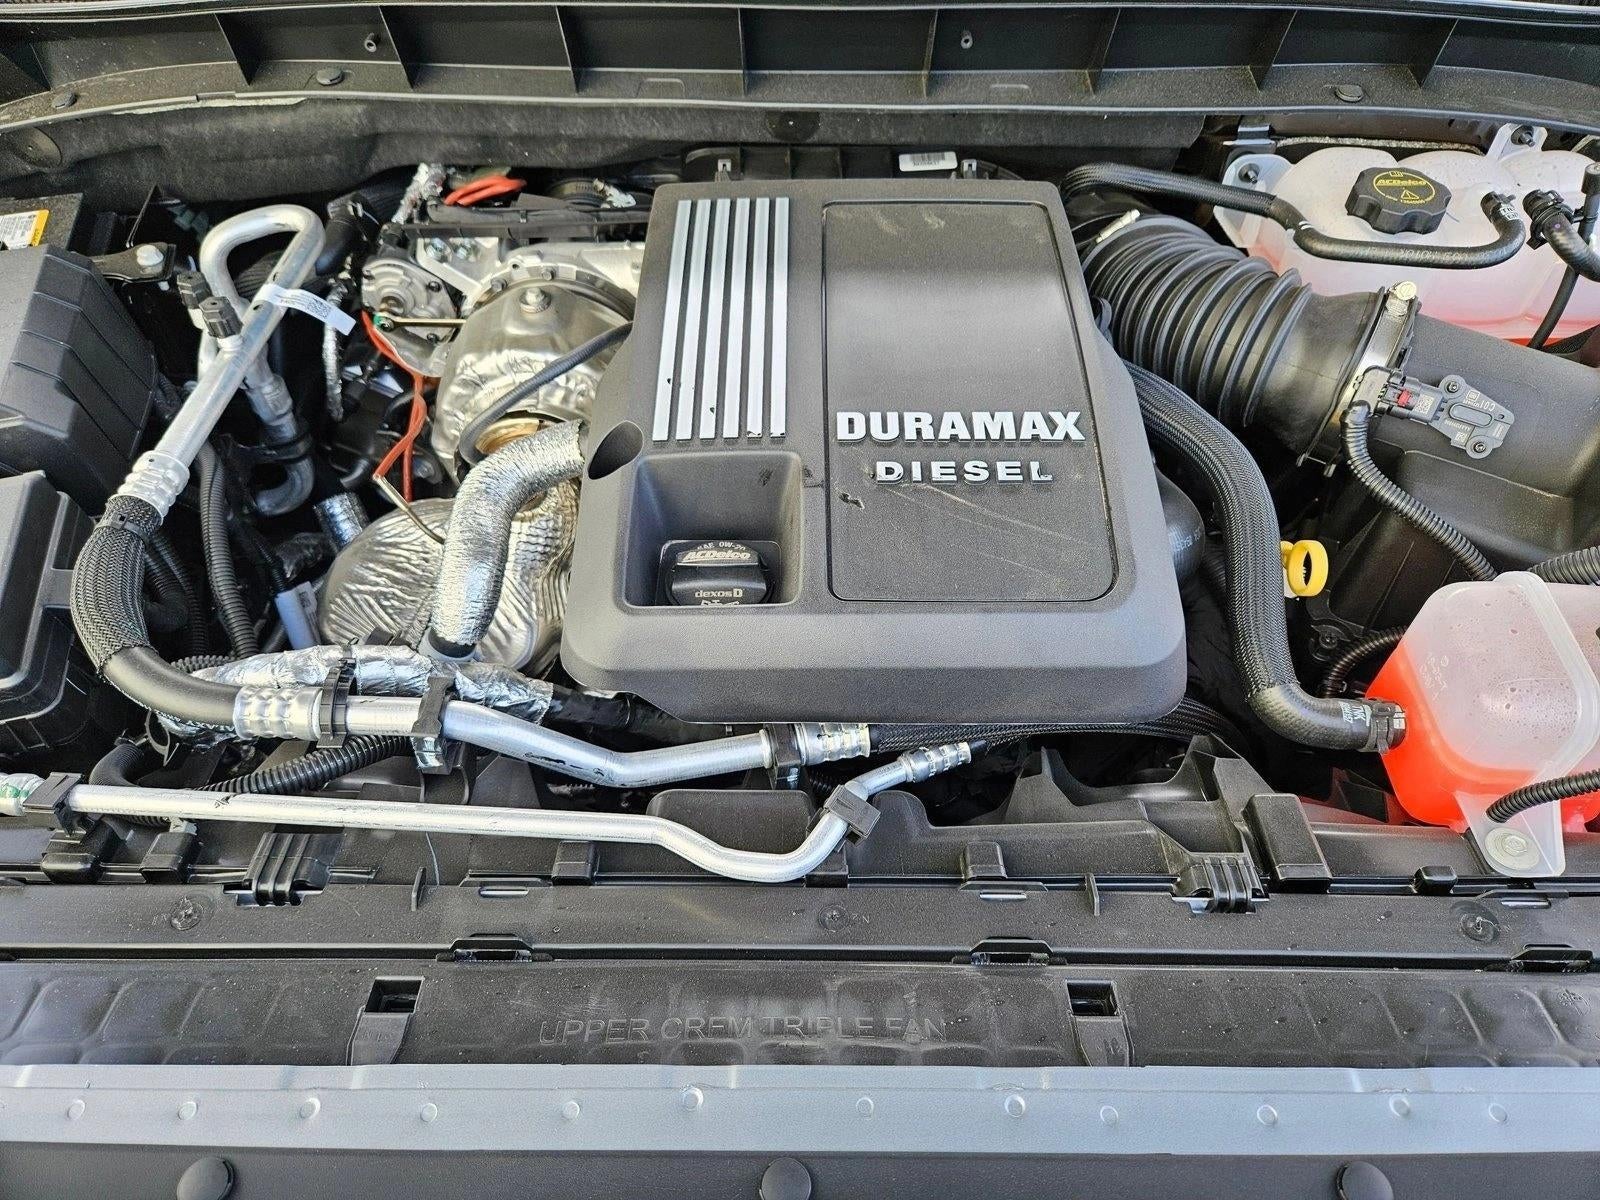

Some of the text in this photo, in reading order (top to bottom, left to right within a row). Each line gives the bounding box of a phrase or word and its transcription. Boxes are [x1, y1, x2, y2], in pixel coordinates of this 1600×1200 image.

[836, 411, 1086, 443] DURAMAX
[875, 460, 1053, 485] DIESEL
[681, 550, 751, 563] ACDelco
[539, 1018, 650, 1045] UPPER
[762, 1016, 876, 1040] TRIPLE
[885, 1017, 947, 1043] FAN
